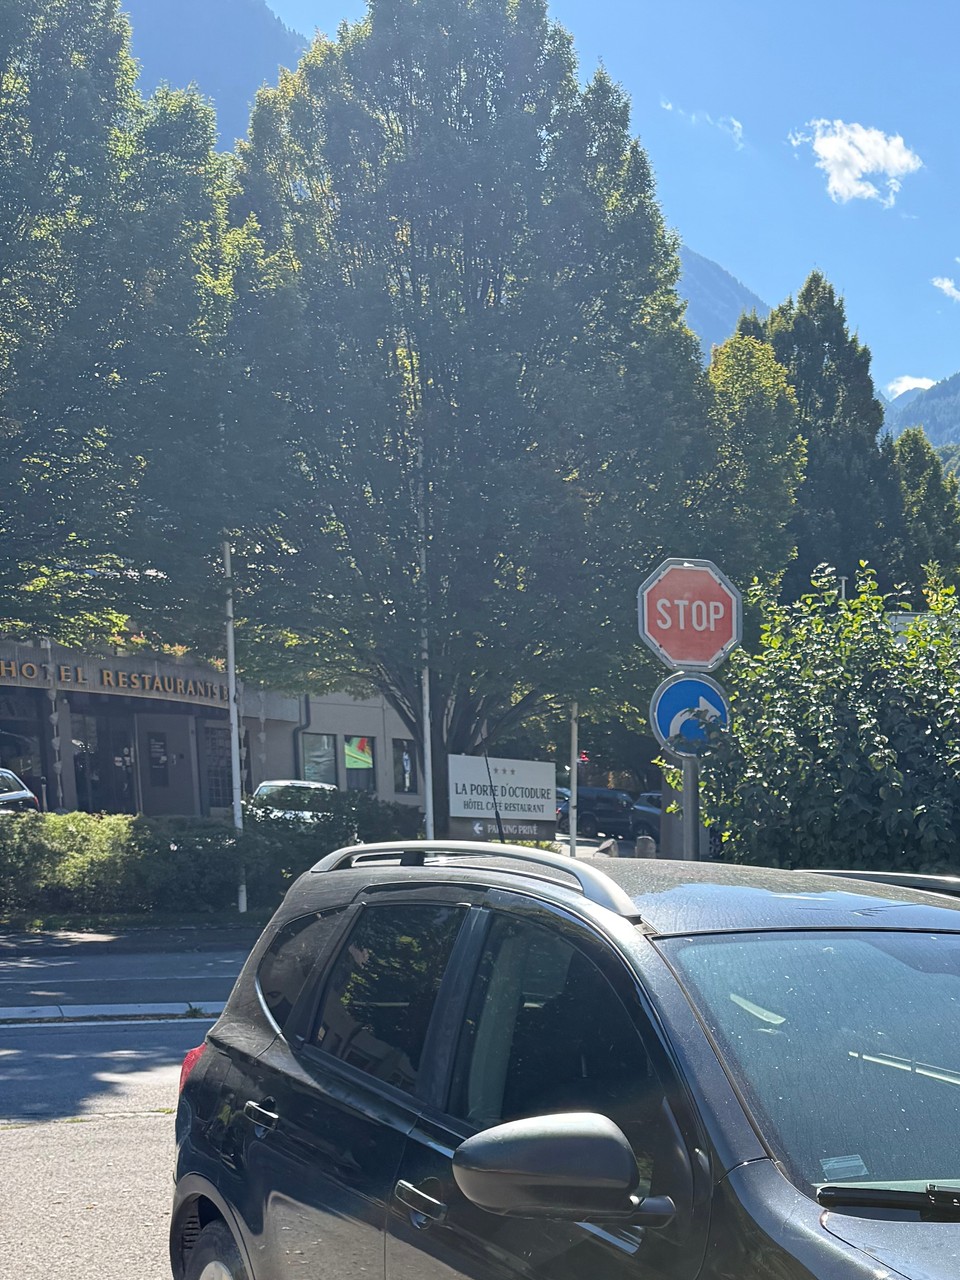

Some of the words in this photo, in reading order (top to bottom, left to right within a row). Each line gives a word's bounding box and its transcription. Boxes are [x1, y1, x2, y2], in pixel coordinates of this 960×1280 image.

[656, 598, 725, 632] STOP
[102, 669, 219, 698] RESTAURANTS
[455, 782, 468, 795] LA
[470, 783, 499, 797] PORTE
[504, 802, 545, 814] RESTAURANT
